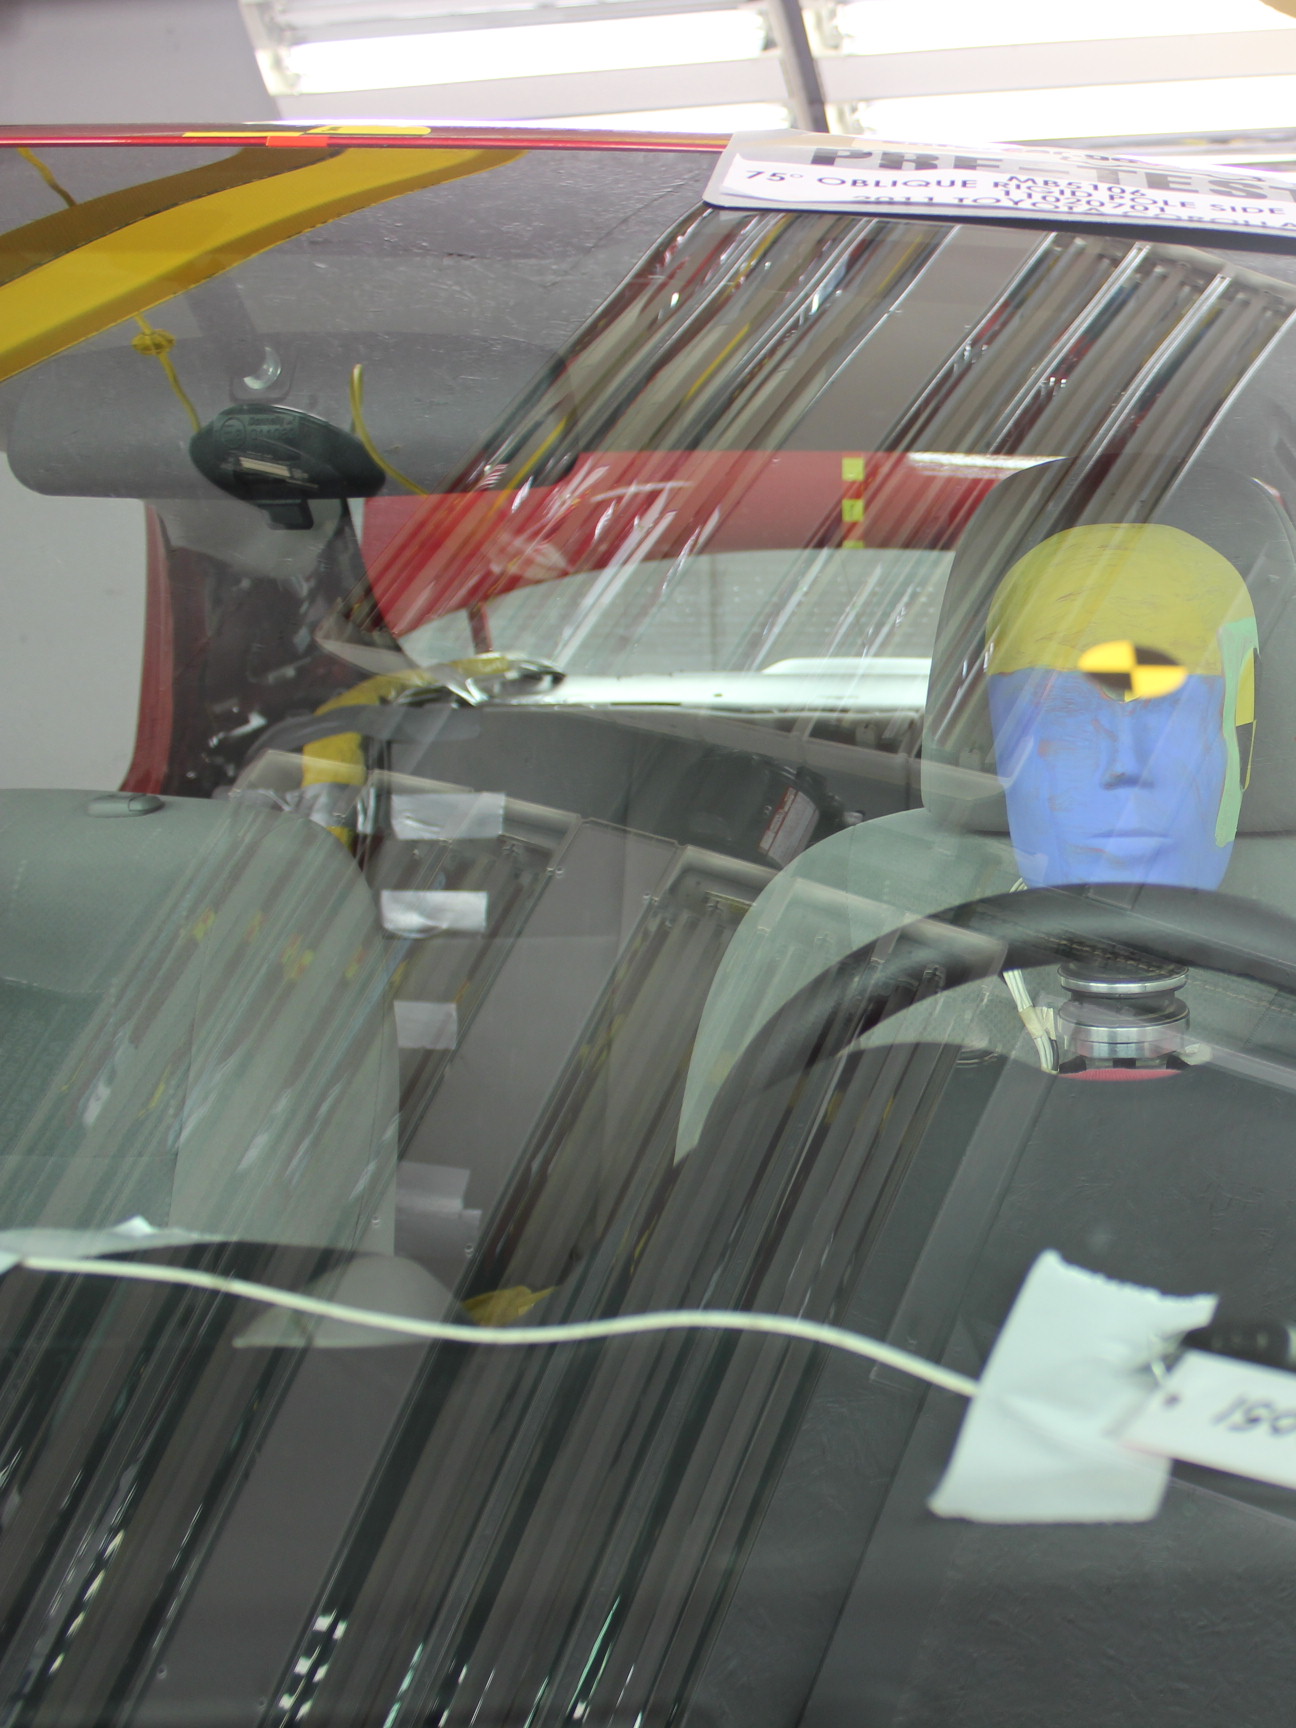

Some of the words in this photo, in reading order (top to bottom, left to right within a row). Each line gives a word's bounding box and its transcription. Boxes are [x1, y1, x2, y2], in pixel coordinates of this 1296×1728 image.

[816, 176, 978, 188] OBLIQUE
[992, 180, 1093, 198] RIGID
[1108, 193, 1196, 208] POLE
[1209, 202, 1284, 215] SIDE
[1006, 175, 1147, 196] MB5106
